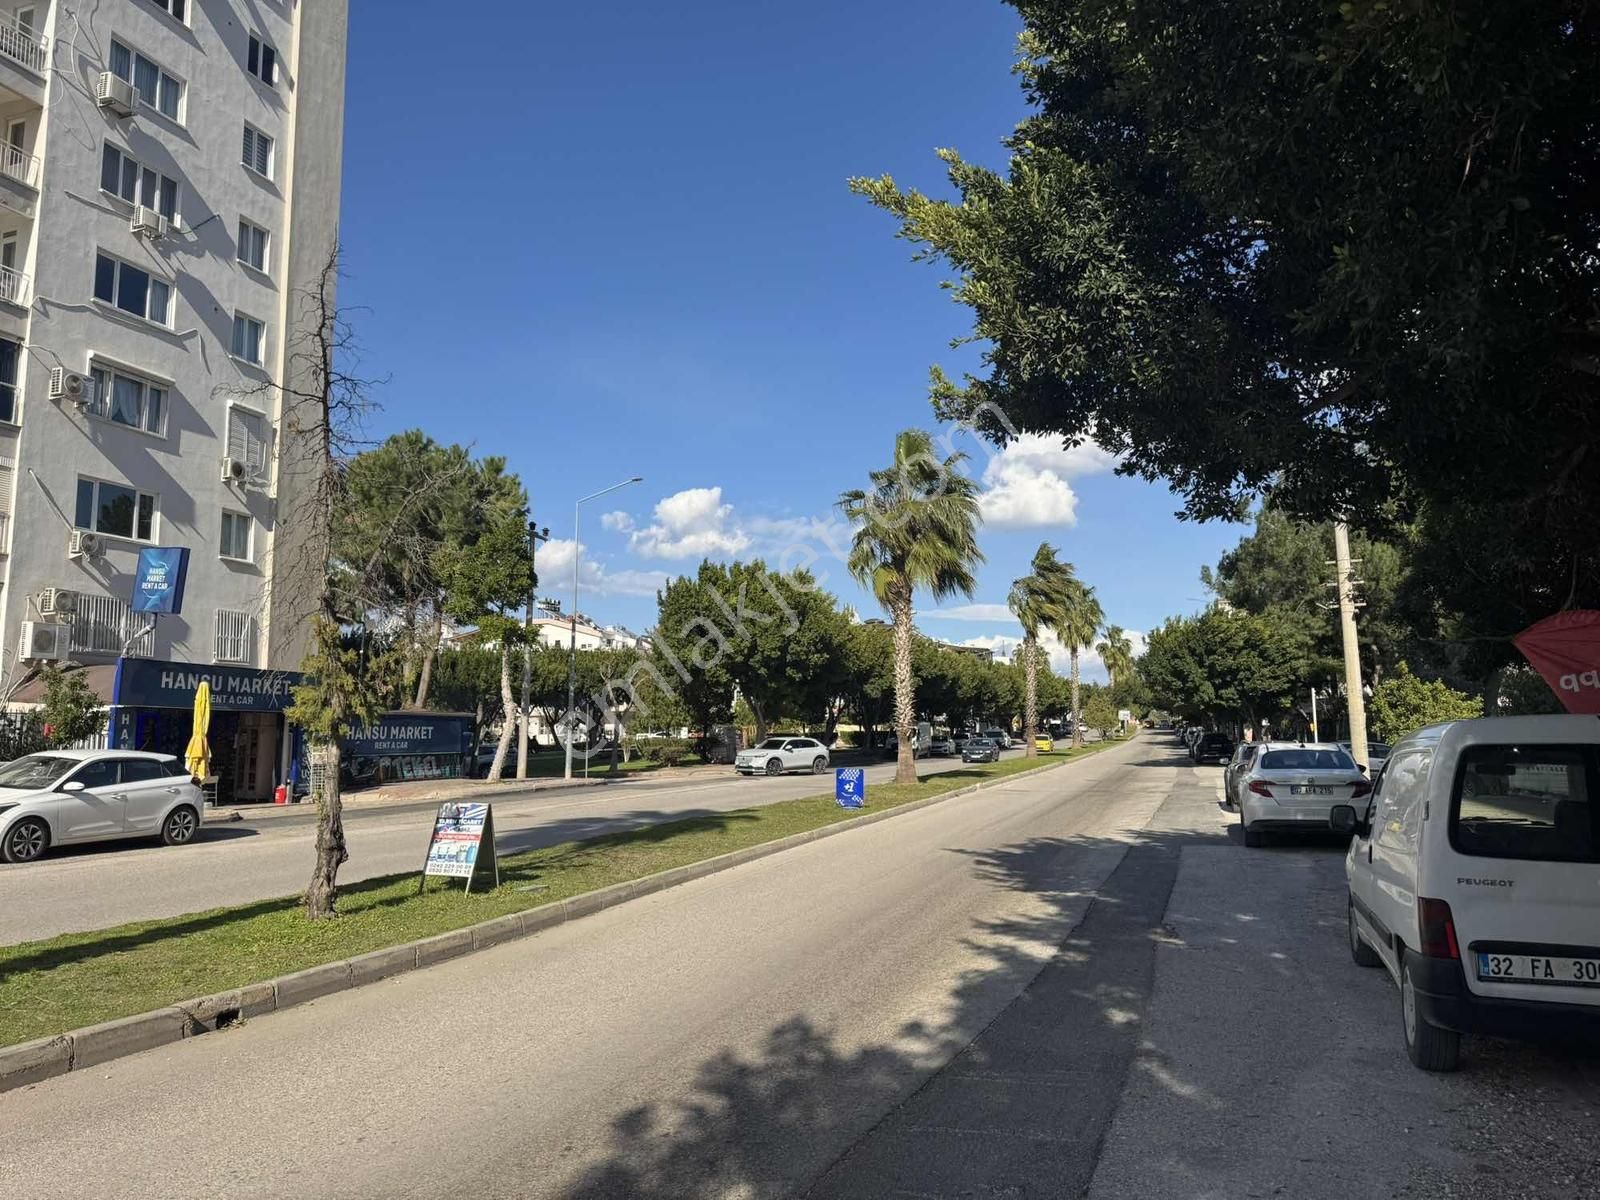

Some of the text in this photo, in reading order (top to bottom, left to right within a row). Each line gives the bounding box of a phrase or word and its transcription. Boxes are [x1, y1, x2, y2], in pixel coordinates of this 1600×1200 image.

[227, 676, 291, 696] MARKET
[228, 695, 235, 704] A
[236, 695, 254, 705] CAR
[346, 725, 434, 740] HANSU MARKET
[374, 741, 390, 750] RENT
[396, 741, 408, 749] CAR
[1457, 877, 1514, 887] PEUGEOT
[1490, 956, 1600, 980] 32 FA 30
